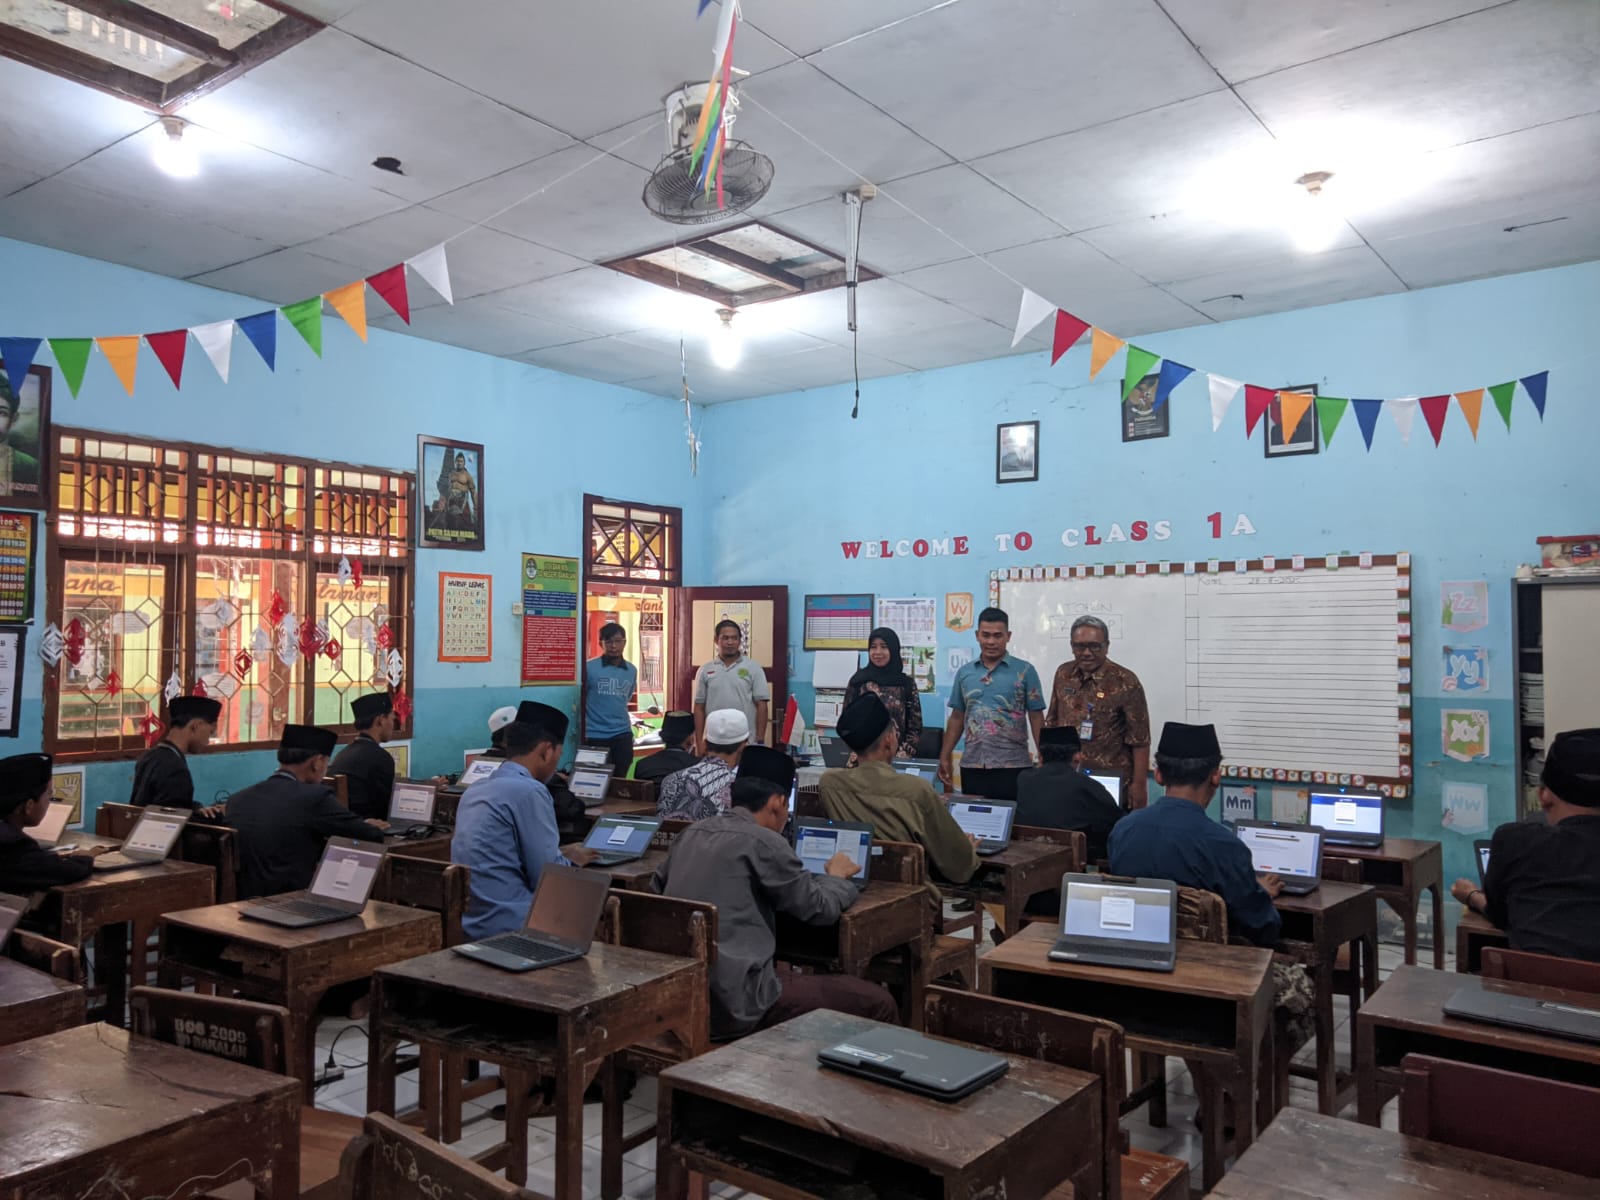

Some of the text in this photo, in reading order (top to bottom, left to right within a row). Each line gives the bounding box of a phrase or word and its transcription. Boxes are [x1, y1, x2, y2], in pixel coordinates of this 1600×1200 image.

[841, 511, 1256, 559] WELCOME TO CLASS 1A
[951, 602, 968, 616] Vv
[1226, 795, 1251, 811] Mm
[209, 1024, 248, 1044] 2009
